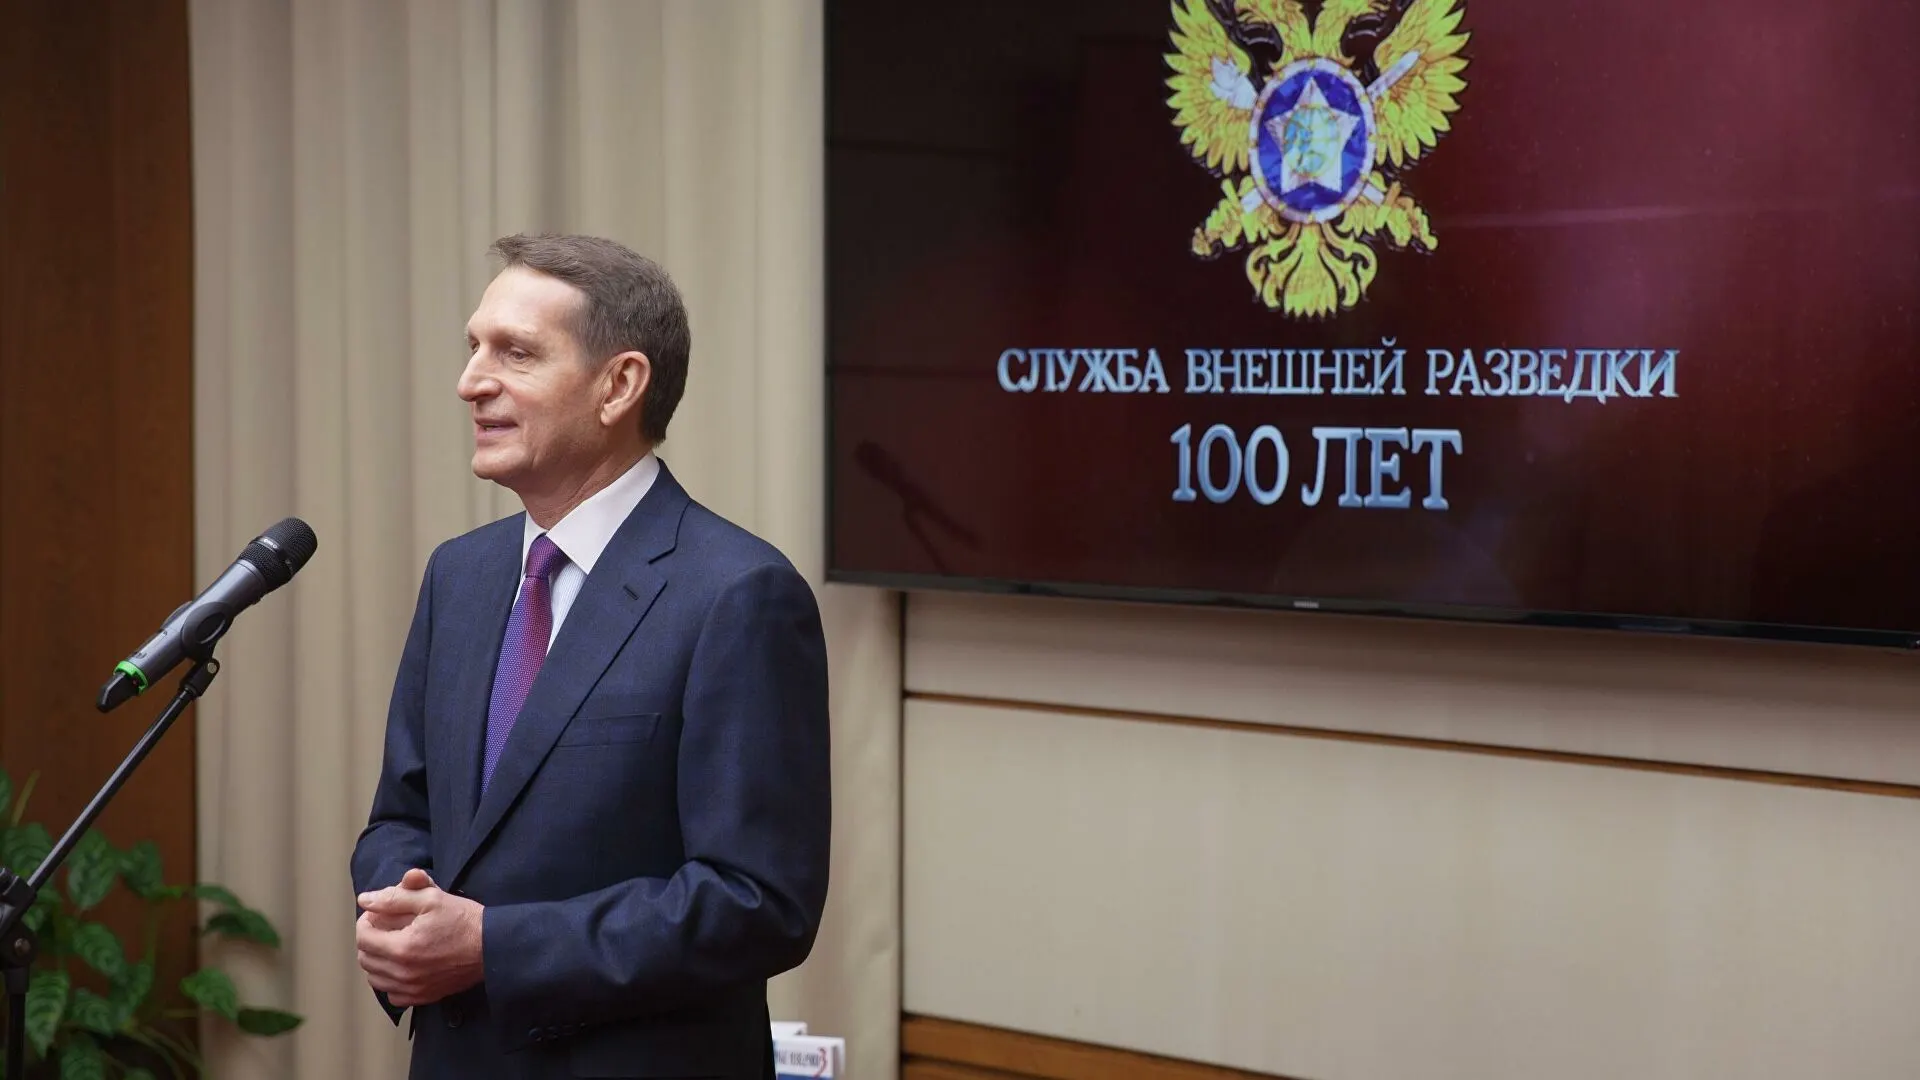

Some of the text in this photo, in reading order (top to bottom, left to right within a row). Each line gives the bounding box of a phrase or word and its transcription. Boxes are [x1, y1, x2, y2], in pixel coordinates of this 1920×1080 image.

[997, 337, 1678, 404] СЛУЖБА ВНЕШНЕЙ РАЗВЕДКИ
[1169, 424, 1462, 509] 100 ЛЕТ
